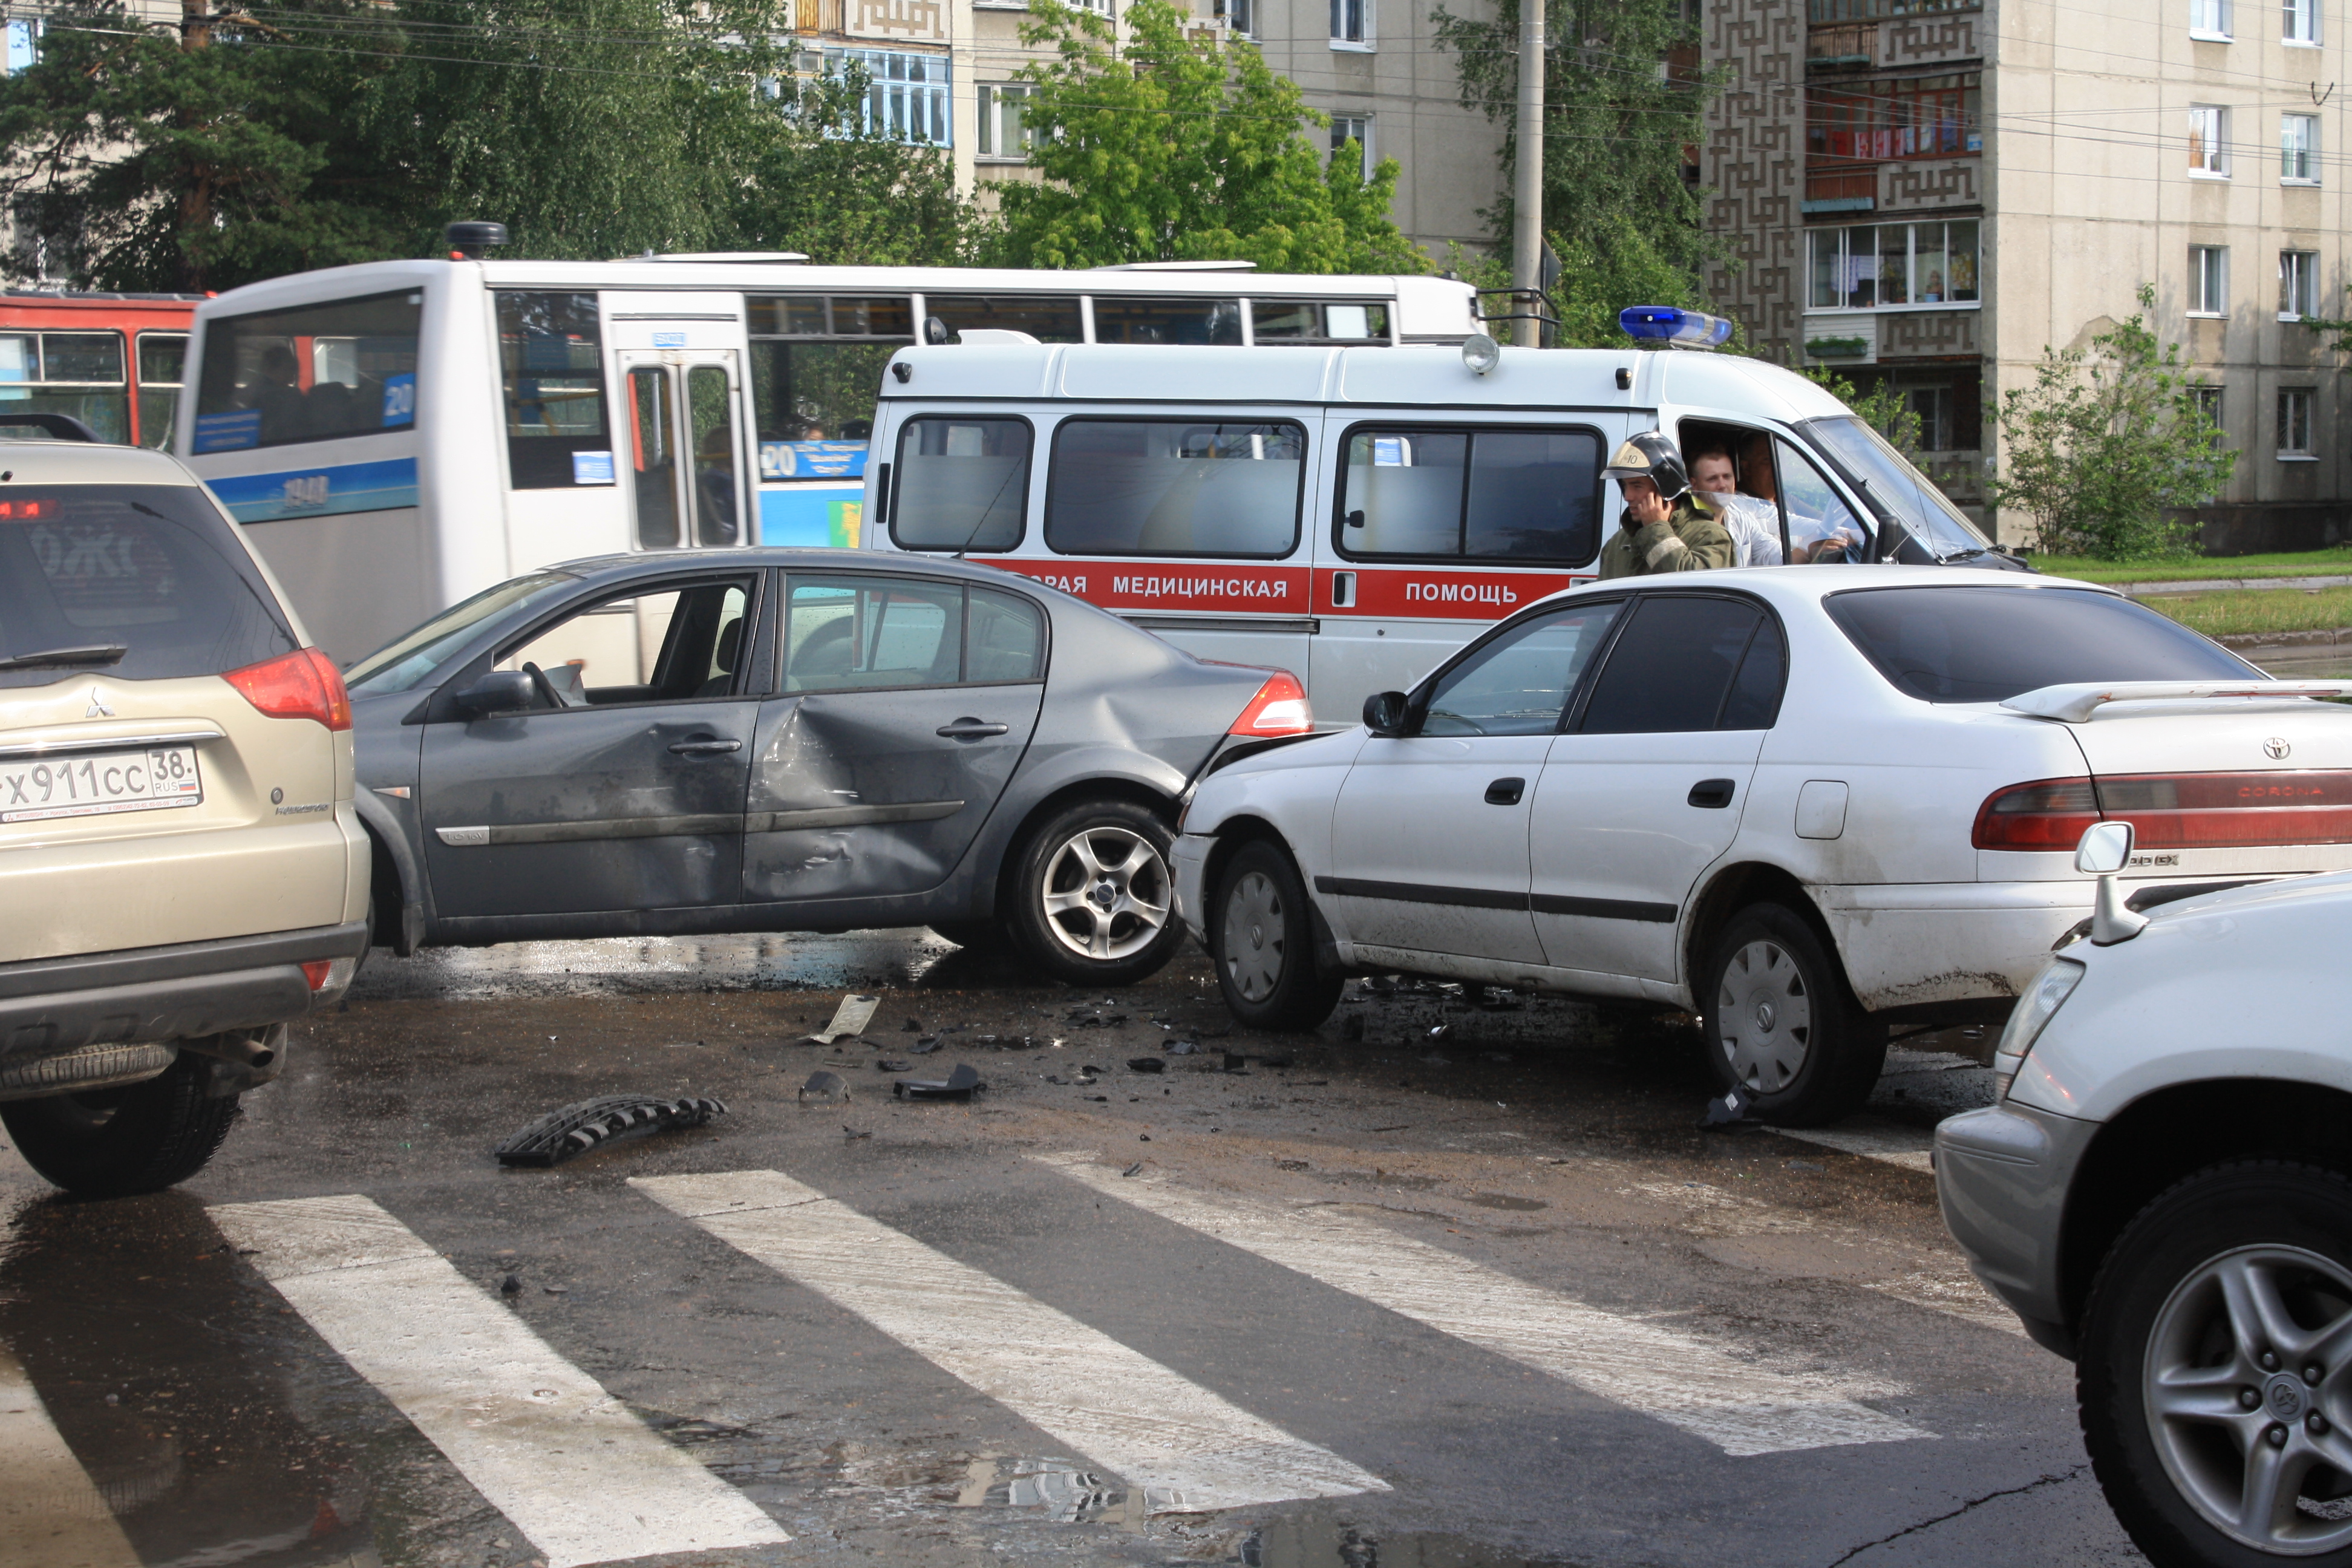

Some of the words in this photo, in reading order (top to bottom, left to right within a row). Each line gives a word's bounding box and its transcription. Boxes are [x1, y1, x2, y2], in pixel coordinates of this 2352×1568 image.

[384, 383, 414, 416] 20
[760, 445, 796, 476] 20
[1627, 454, 1638, 465] 10
[1112, 576, 1288, 598] МЕДИЦИНСКАЯ
[1406, 583, 1517, 606] ПОМОЩЬ
[151, 750, 185, 780] 38
[155, 782, 178, 792] RUS
[2238, 786, 2324, 798] CORONA
